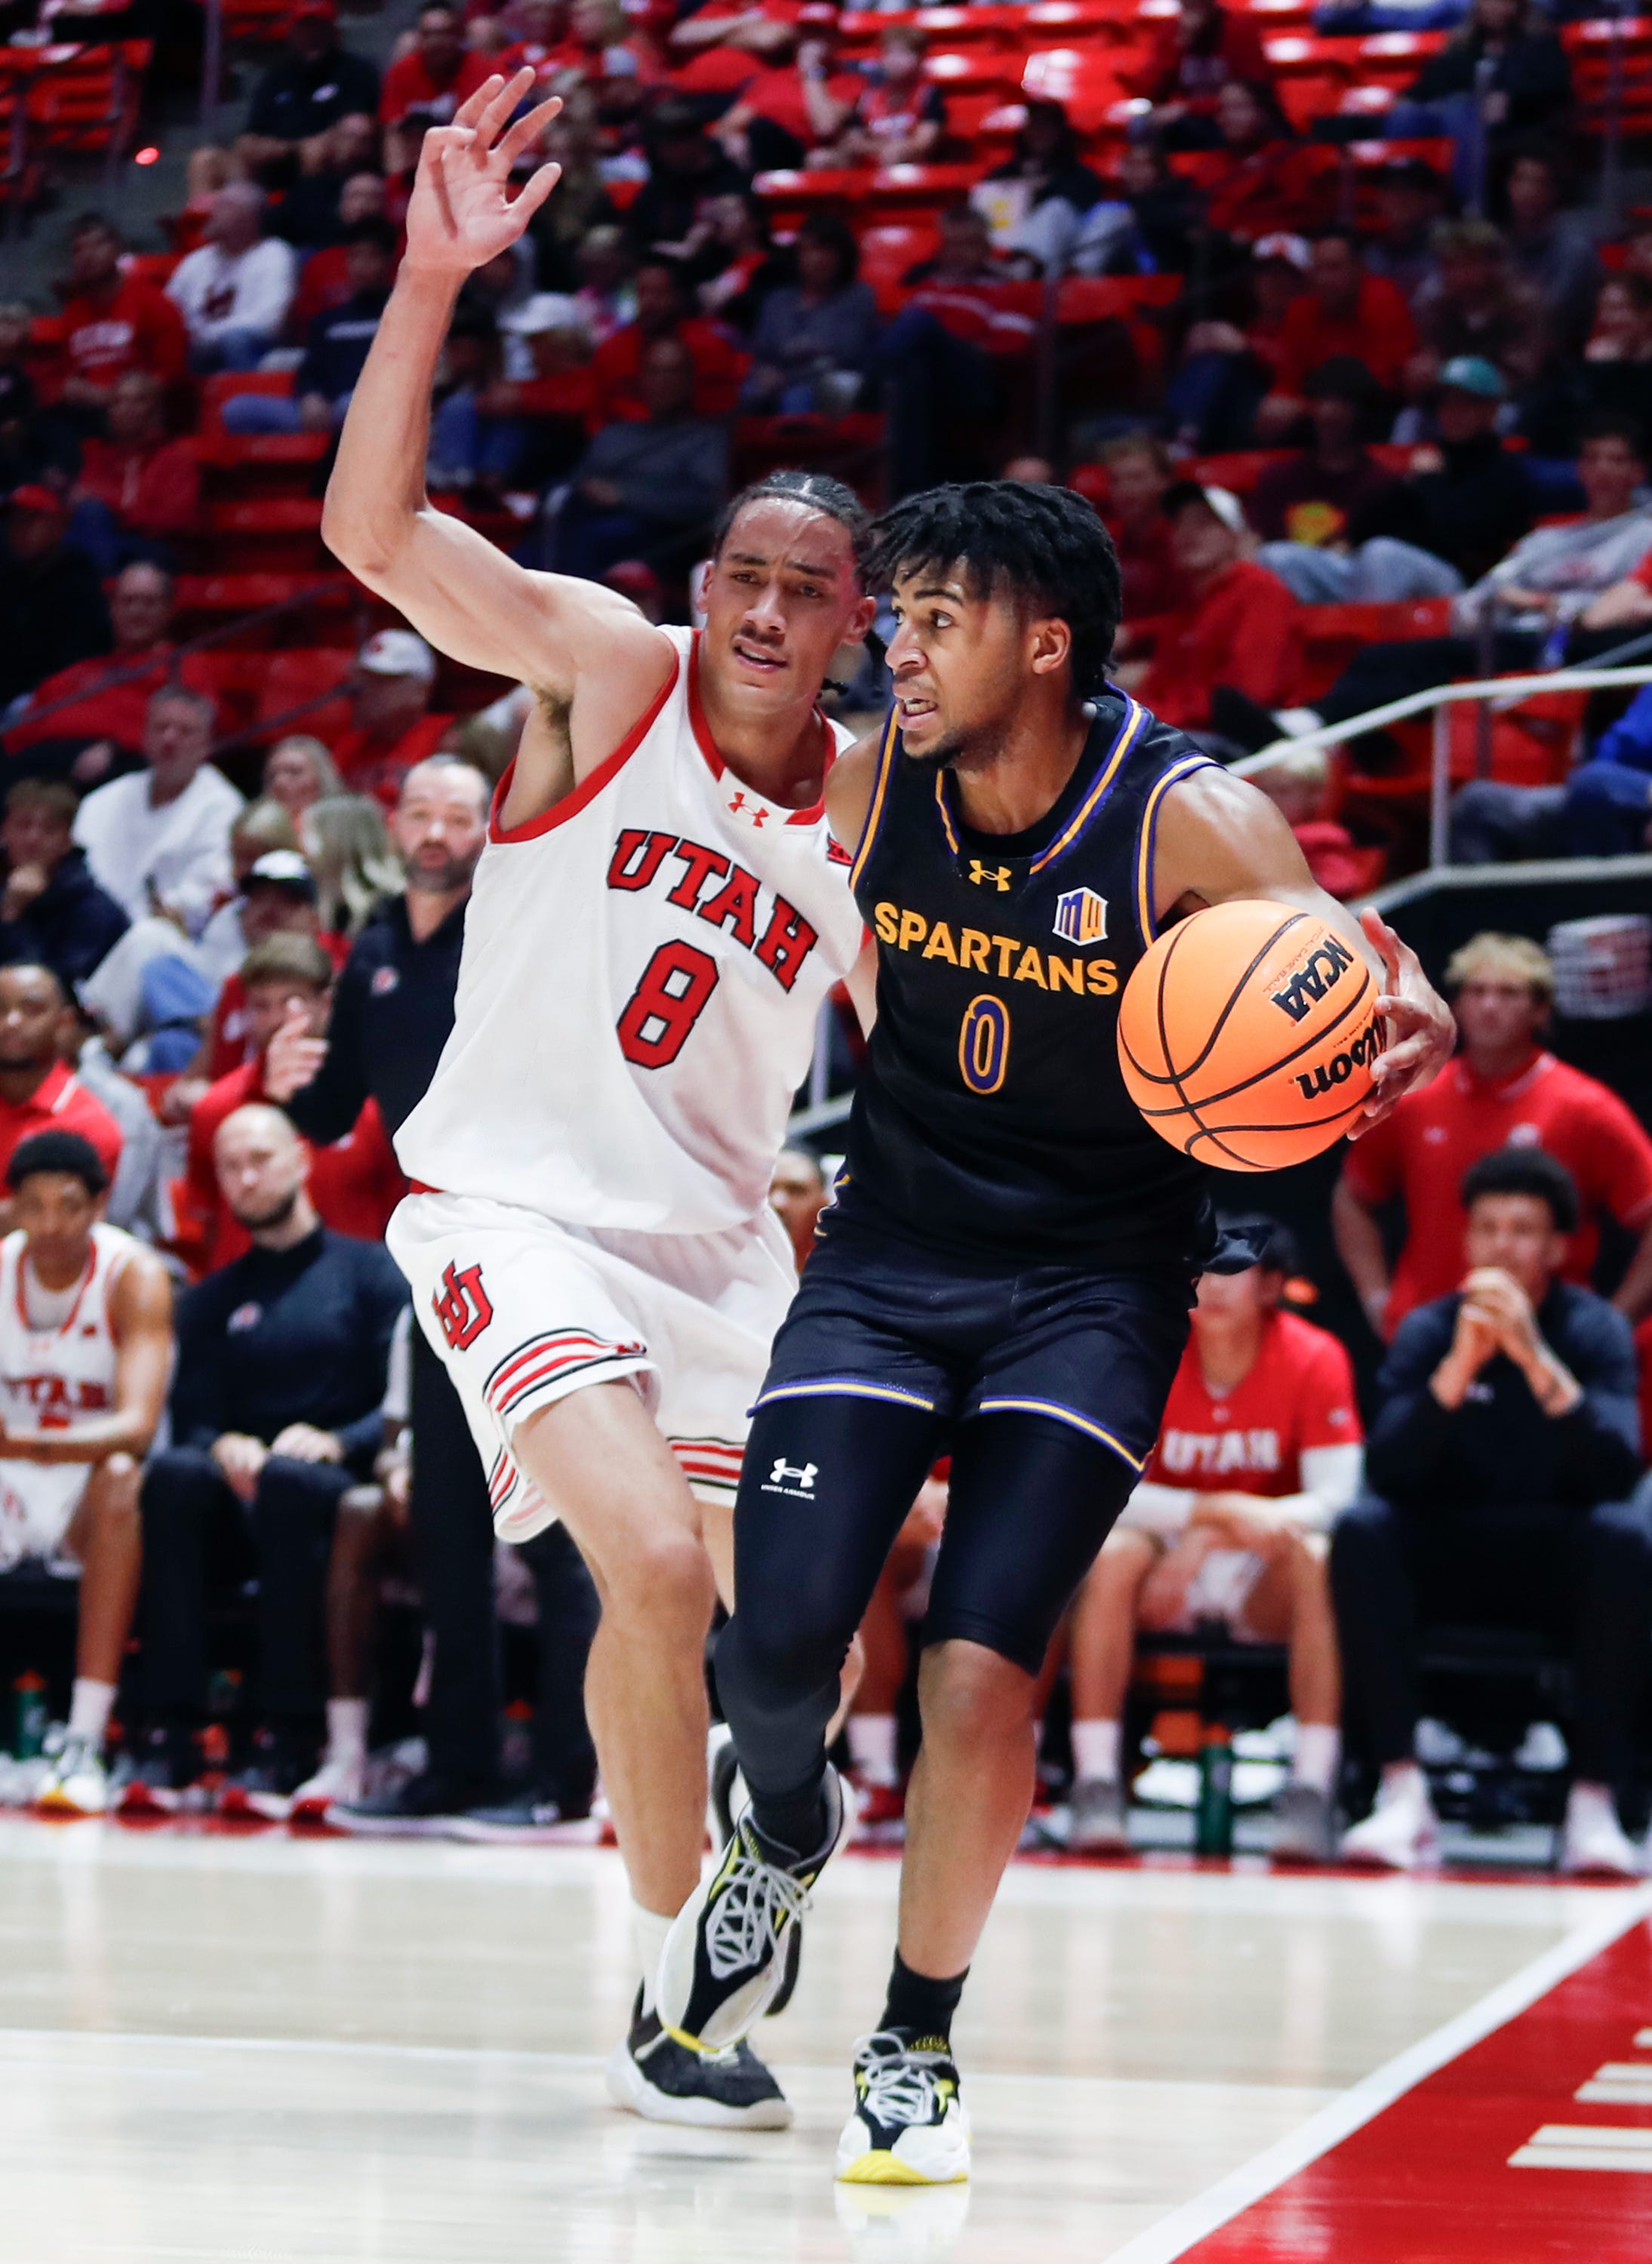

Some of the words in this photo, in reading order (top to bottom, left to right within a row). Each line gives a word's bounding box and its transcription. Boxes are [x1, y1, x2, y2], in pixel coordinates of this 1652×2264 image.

[607, 829, 819, 994] UTAH
[874, 902, 1118, 995] SPARTANS
[616, 938, 719, 1069] 8
[1270, 934, 1354, 1022] NCAA
[958, 994, 1010, 1095] 0
[1161, 1428, 1281, 1475] UTAH
